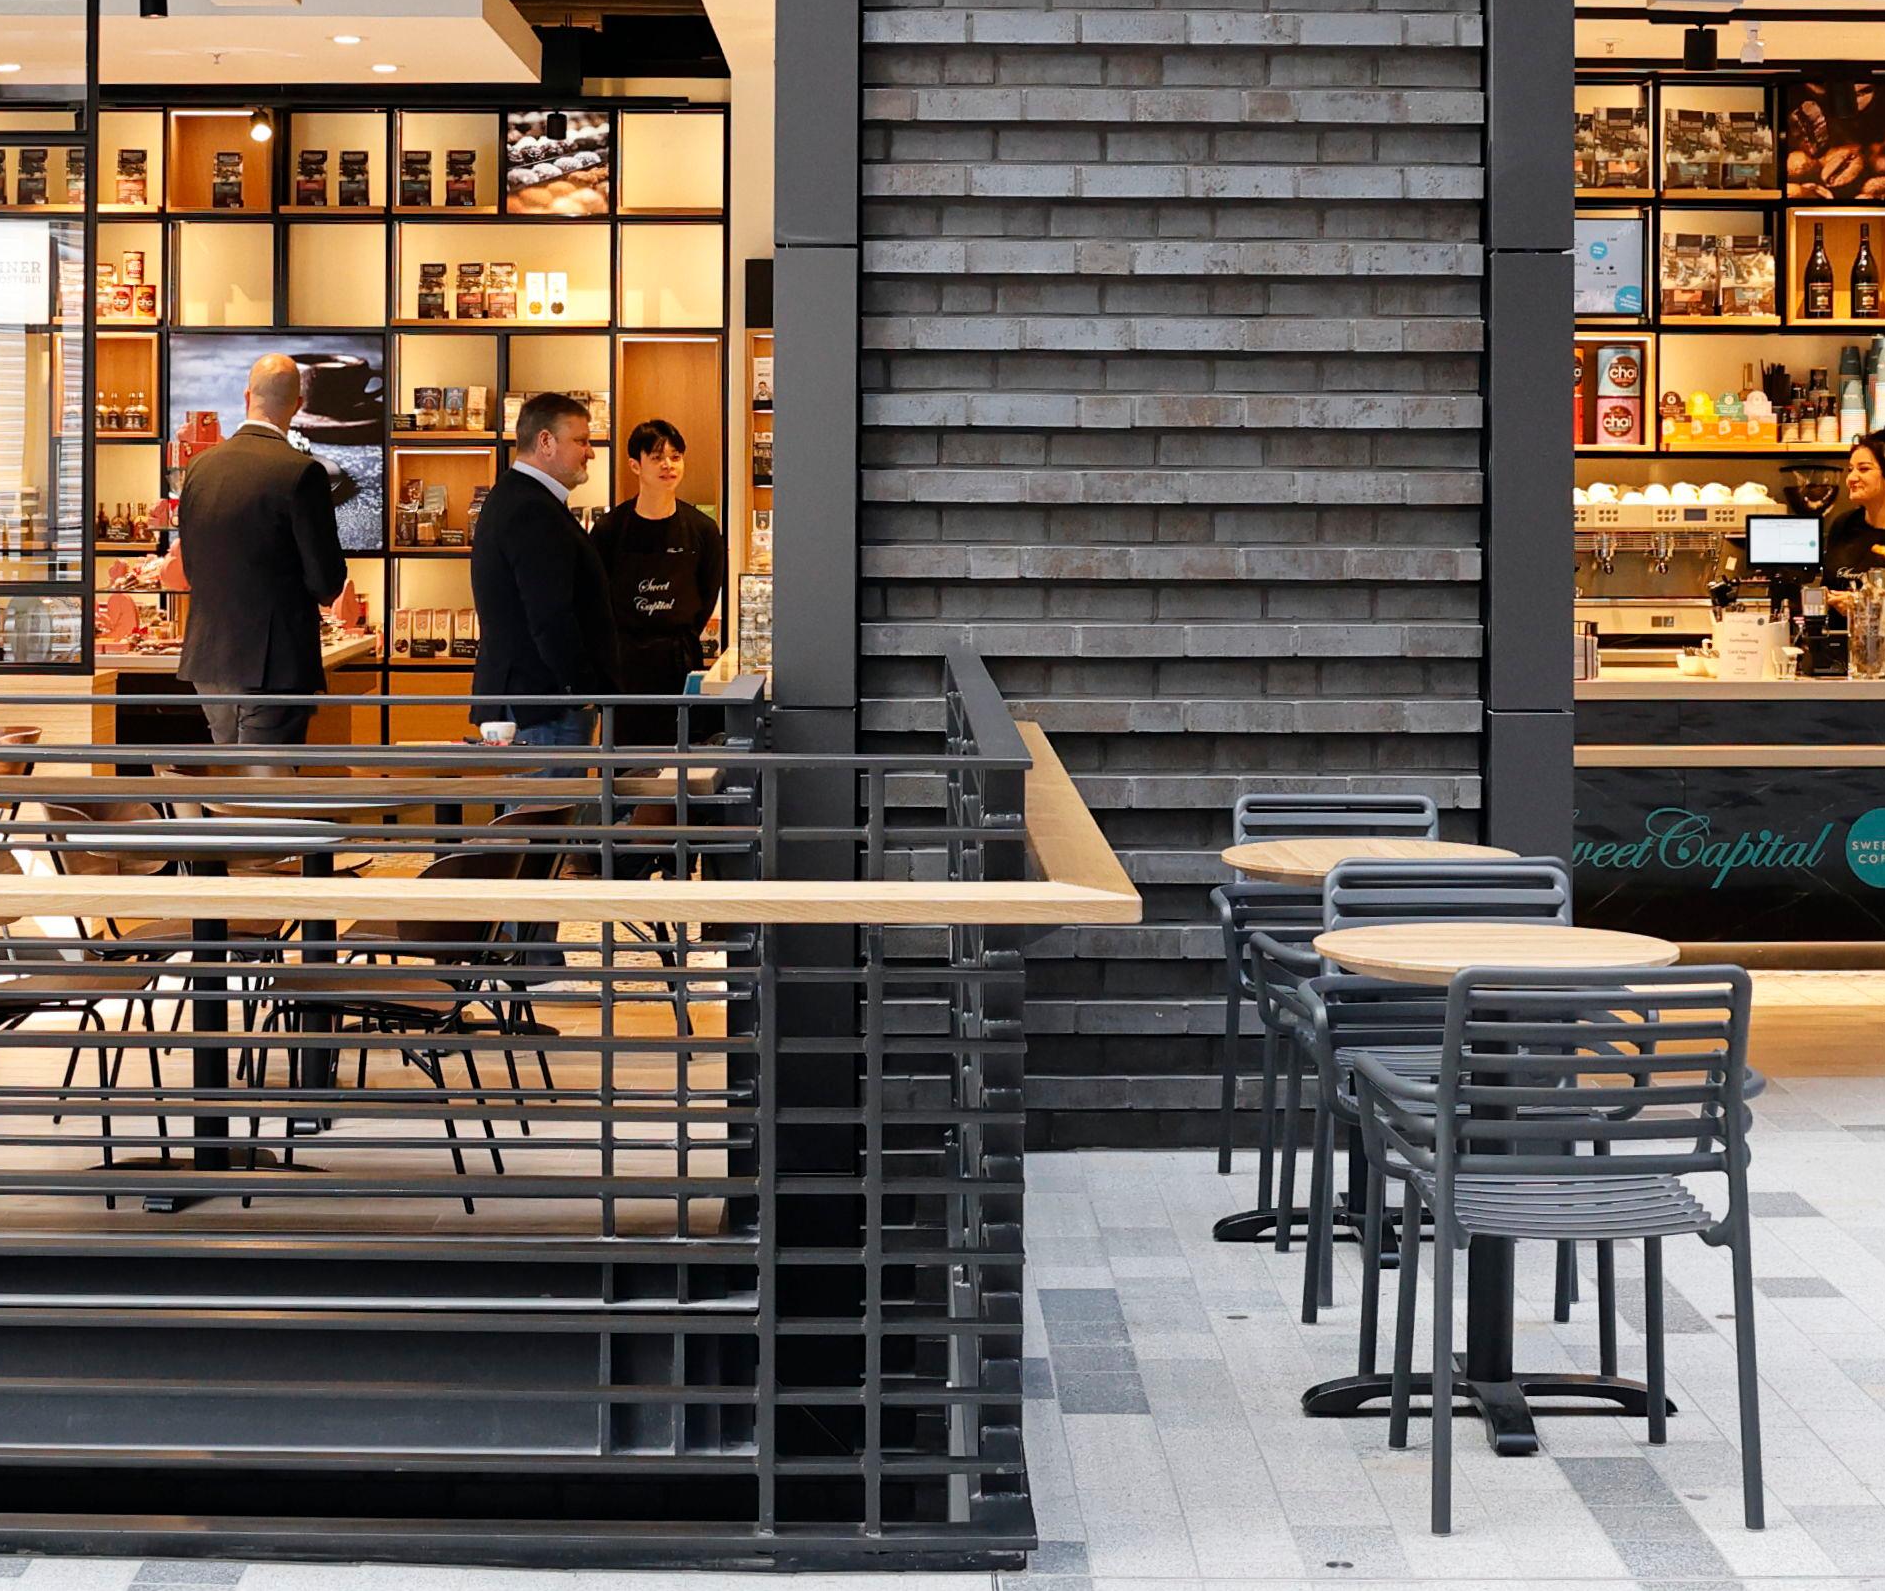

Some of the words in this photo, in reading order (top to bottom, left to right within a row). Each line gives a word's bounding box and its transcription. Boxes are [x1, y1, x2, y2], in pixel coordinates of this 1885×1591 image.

[1609, 364, 1638, 379] chai
[1602, 414, 1633, 428] chai
[638, 578, 670, 594] Sweet
[634, 596, 675, 616] Capital
[1645, 807, 1835, 889] Capital
